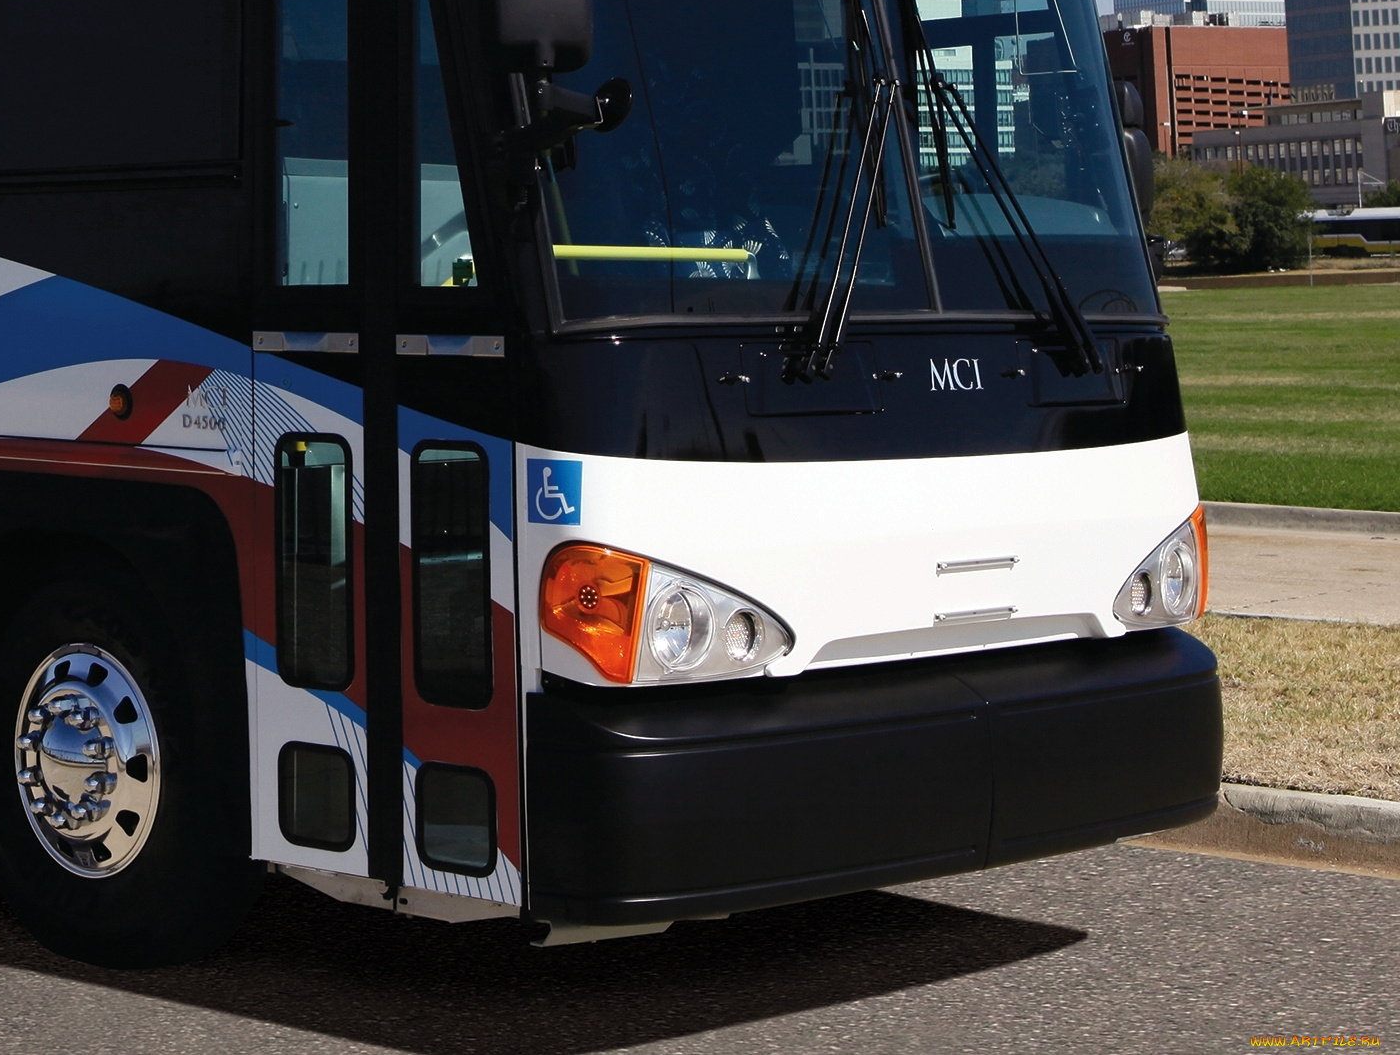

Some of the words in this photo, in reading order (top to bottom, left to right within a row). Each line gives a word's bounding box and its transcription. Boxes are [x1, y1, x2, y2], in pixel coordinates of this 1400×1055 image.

[1386, 118, 1400, 133] Th
[930, 358, 984, 391] MCI
[186, 384, 228, 411] MCI
